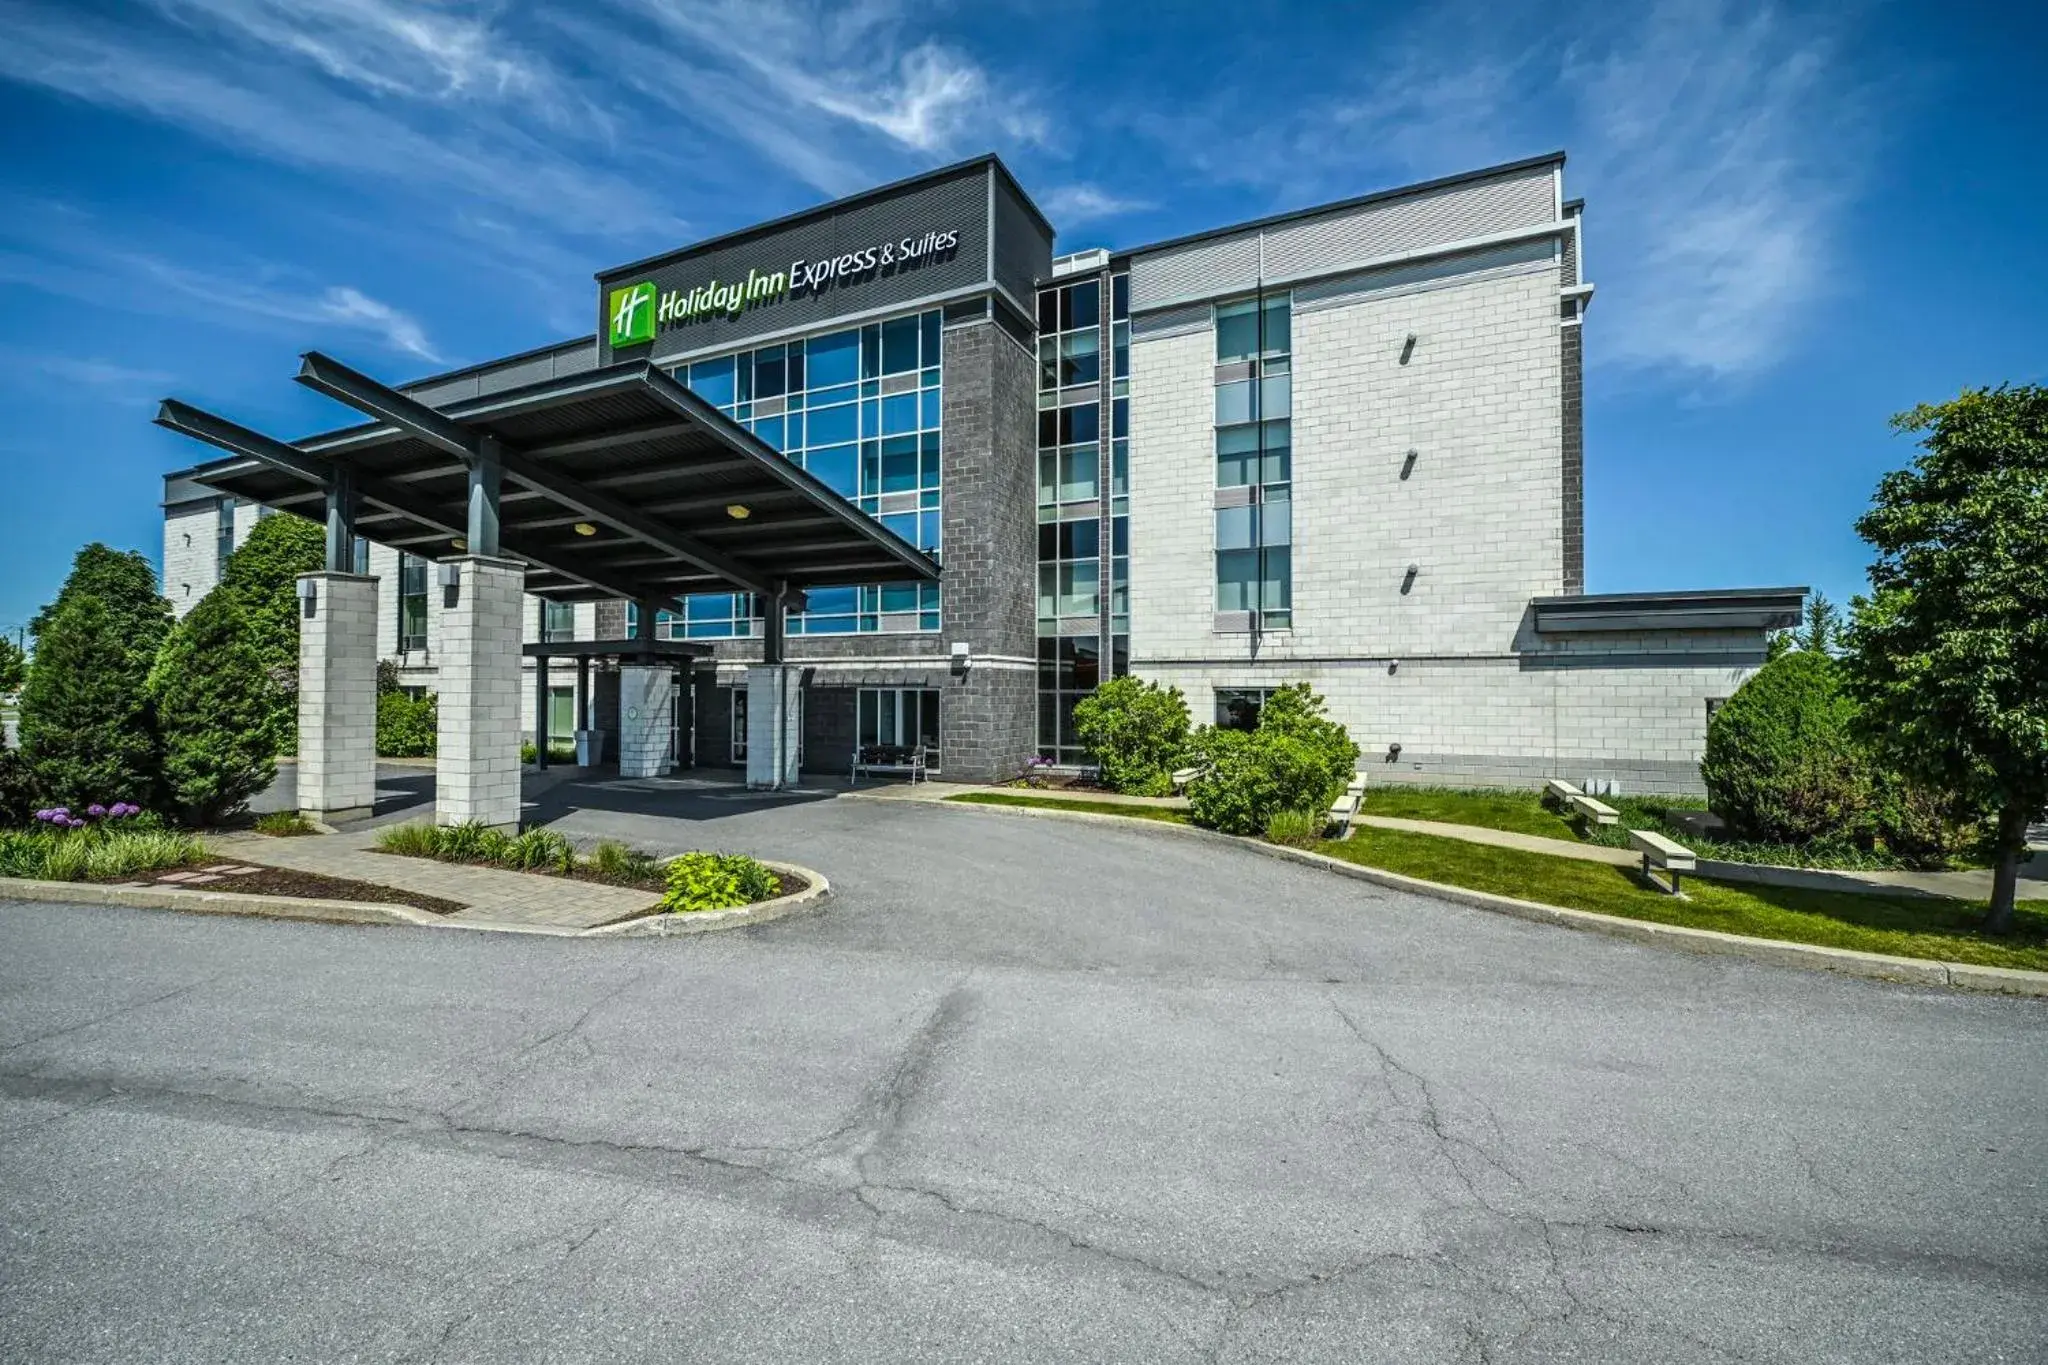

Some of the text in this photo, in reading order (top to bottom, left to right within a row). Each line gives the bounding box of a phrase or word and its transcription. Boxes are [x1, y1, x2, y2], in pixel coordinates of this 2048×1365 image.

[658, 229, 959, 322] Holiday Inn Express & Suites
